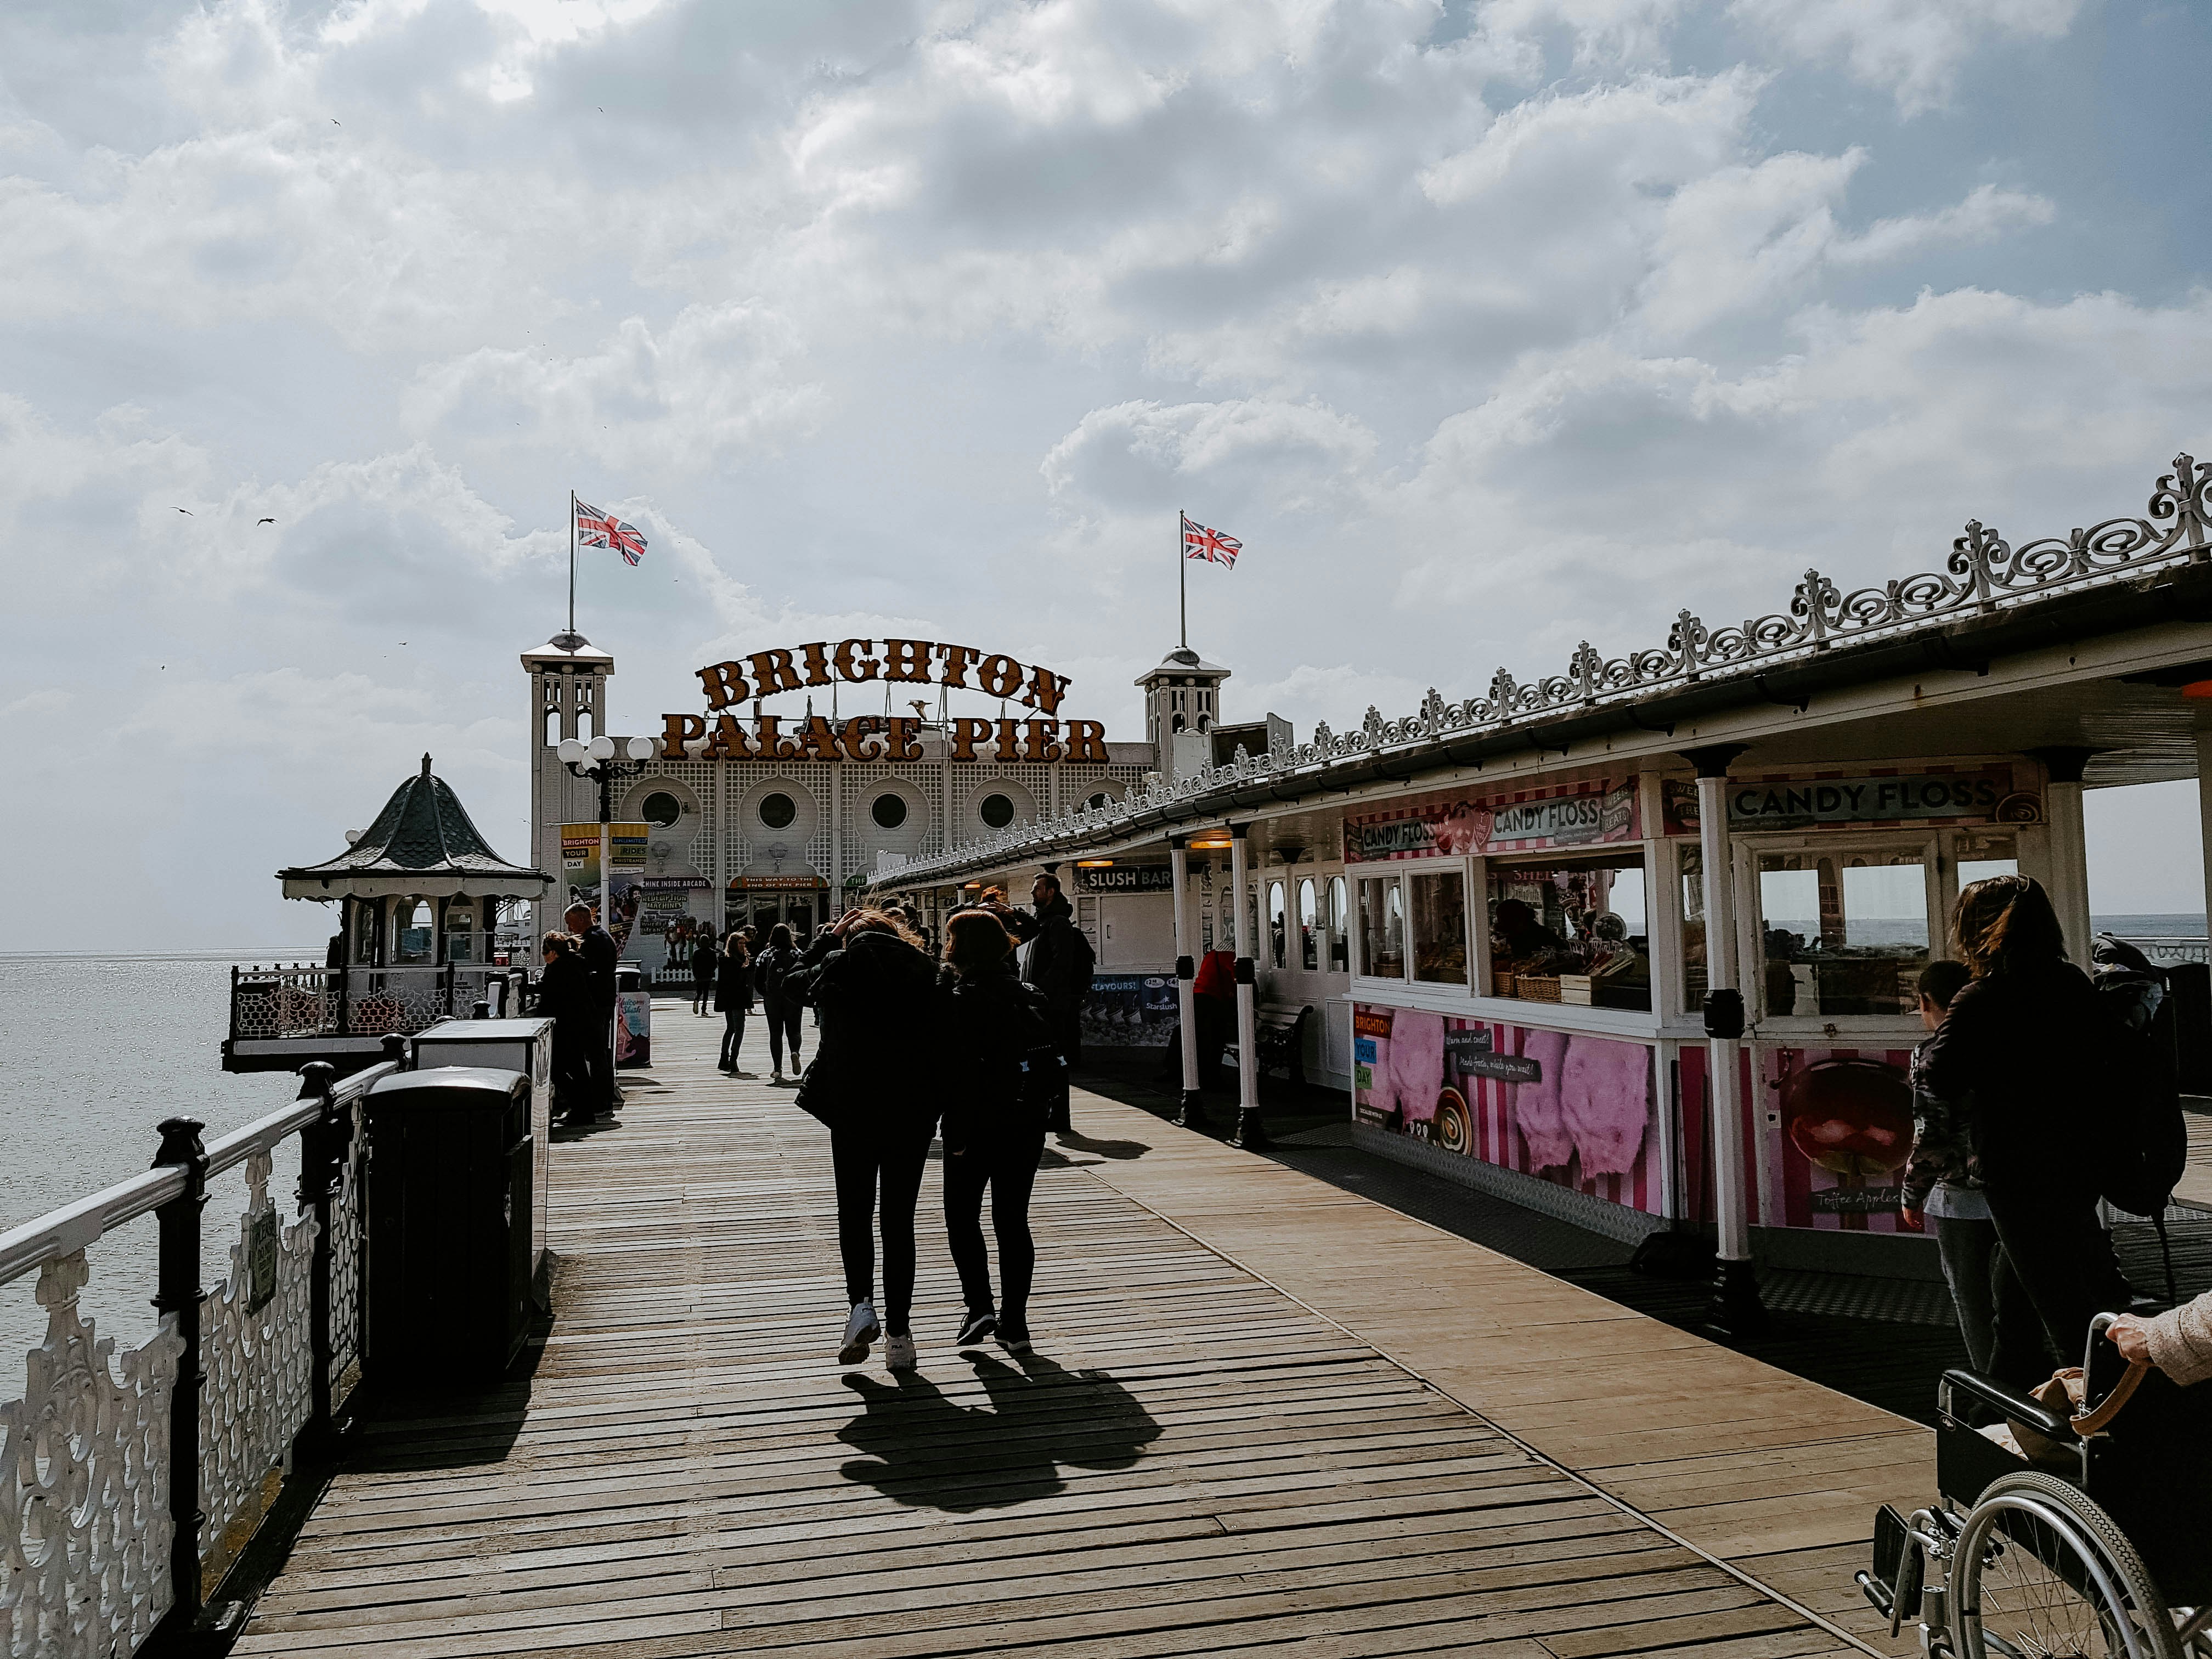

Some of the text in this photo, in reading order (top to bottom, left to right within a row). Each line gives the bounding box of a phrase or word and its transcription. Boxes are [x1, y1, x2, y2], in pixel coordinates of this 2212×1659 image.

[695, 639, 1072, 716] BRIGHTON
[662, 714, 1110, 764] PALACE PIER
[1669, 785, 1699, 797] SWEE
[1735, 779, 1997, 816] CANDY FLOSS
[1494, 799, 1599, 833] CANDY FLOSS
[1364, 824, 1400, 848] CANDY
[1402, 820, 1437, 843] FLOSS
[1089, 871, 1171, 887] SLUSH BAR
[642, 894, 687, 902] REDEMPTION
[1356, 1015, 1391, 1034] BRIGHTON
[1356, 1042, 1375, 1059] YOUR
[1356, 1070, 1370, 1083] DAY
[1815, 1188, 1899, 1210] Toffee Apples
